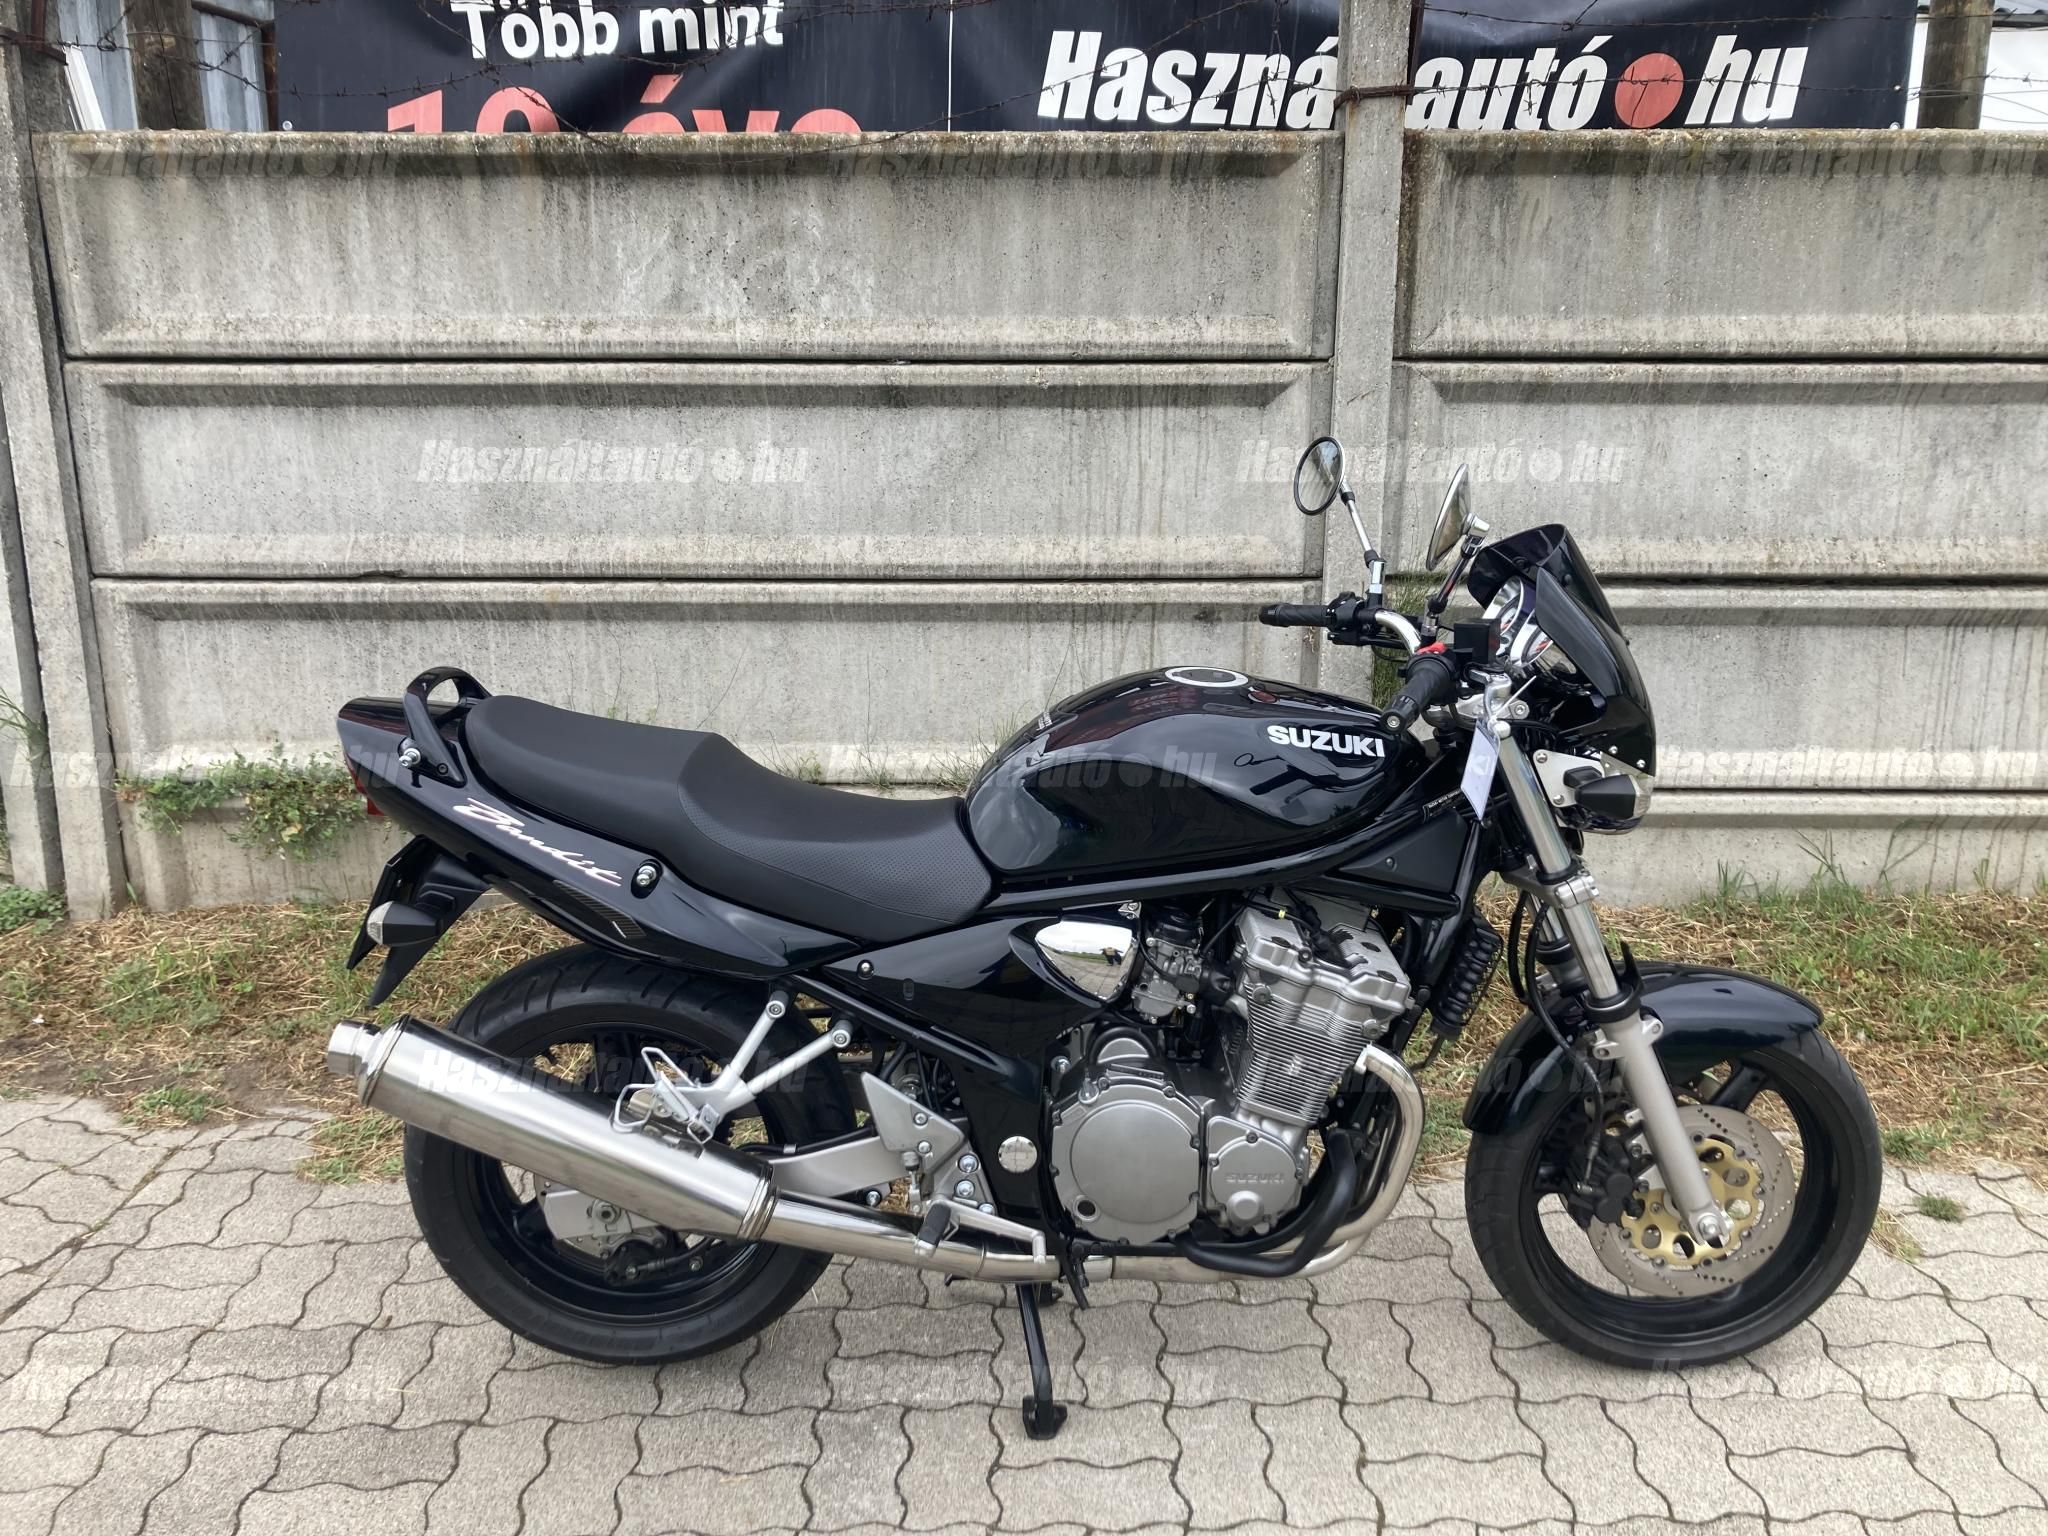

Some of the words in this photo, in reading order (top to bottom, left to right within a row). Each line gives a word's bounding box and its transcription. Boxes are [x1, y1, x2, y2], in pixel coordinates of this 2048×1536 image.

[452, 0, 619, 59] Több
[639, 0, 784, 54] mint
[1267, 725, 1385, 757] SUZUKI
[453, 797, 622, 887] Bandit
[1225, 1171, 1284, 1185] SUZUKI
